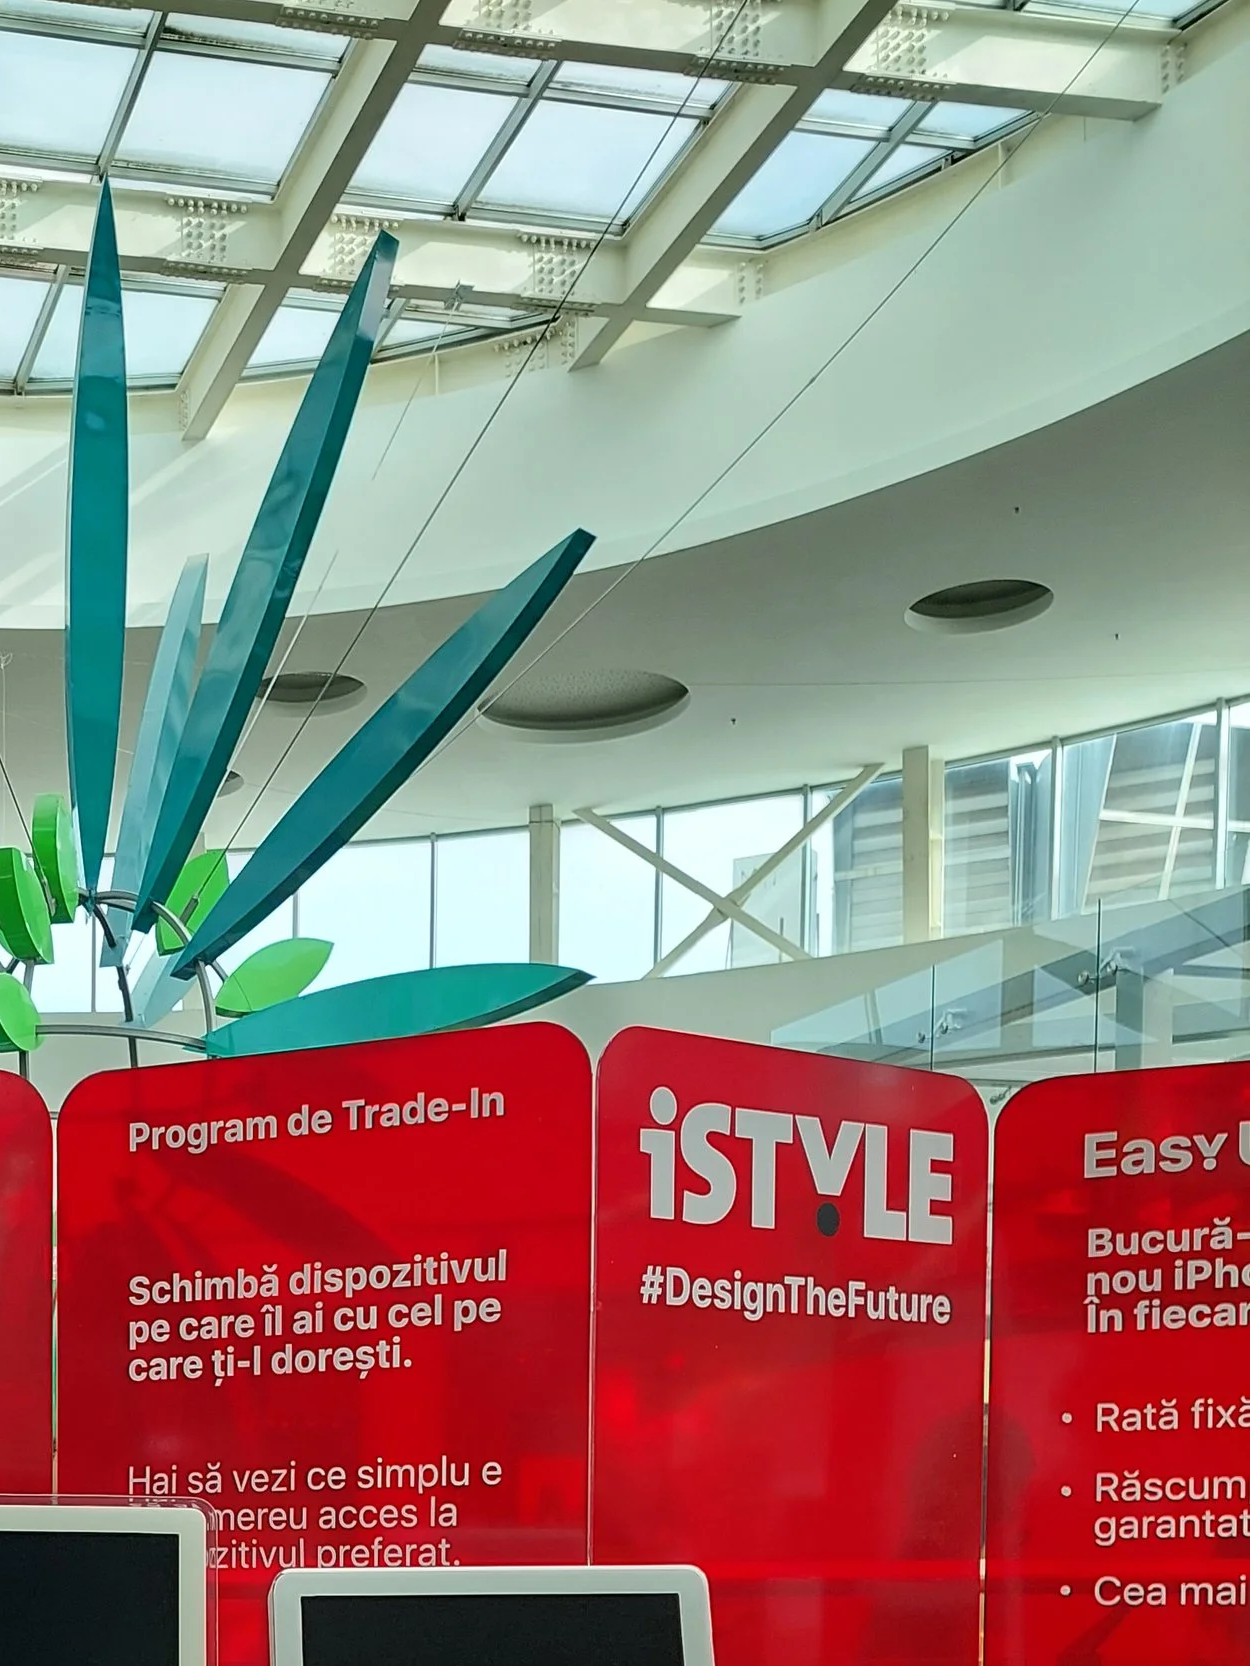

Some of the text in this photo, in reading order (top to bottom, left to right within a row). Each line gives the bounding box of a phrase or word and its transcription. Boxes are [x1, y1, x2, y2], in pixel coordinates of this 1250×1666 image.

[129, 1087, 505, 1154] Program de Trade-In
[639, 1086, 954, 1246] iSTYLE
[1084, 1131, 1228, 1178] Easy
[1088, 1216, 1250, 1258] Bucură-
[128, 1249, 508, 1306] Schimbă dispozitivul
[640, 1265, 952, 1325] #DesignTheFuture
[1087, 1268, 1162, 1295] nou
[128, 1295, 502, 1350] pe care îl ai cu cel pe
[1083, 1296, 1123, 1333] În
[128, 1349, 203, 1382] care
[270, 1336, 413, 1379] dorești.
[1096, 1398, 1179, 1432] Rată
[128, 1456, 503, 1495] Hai să vezi ce simplu e
[318, 1502, 418, 1529] acces
[429, 1496, 458, 1528] la
[317, 1536, 461, 1566] preferat.
[1094, 1574, 1247, 1606] Cea mai
